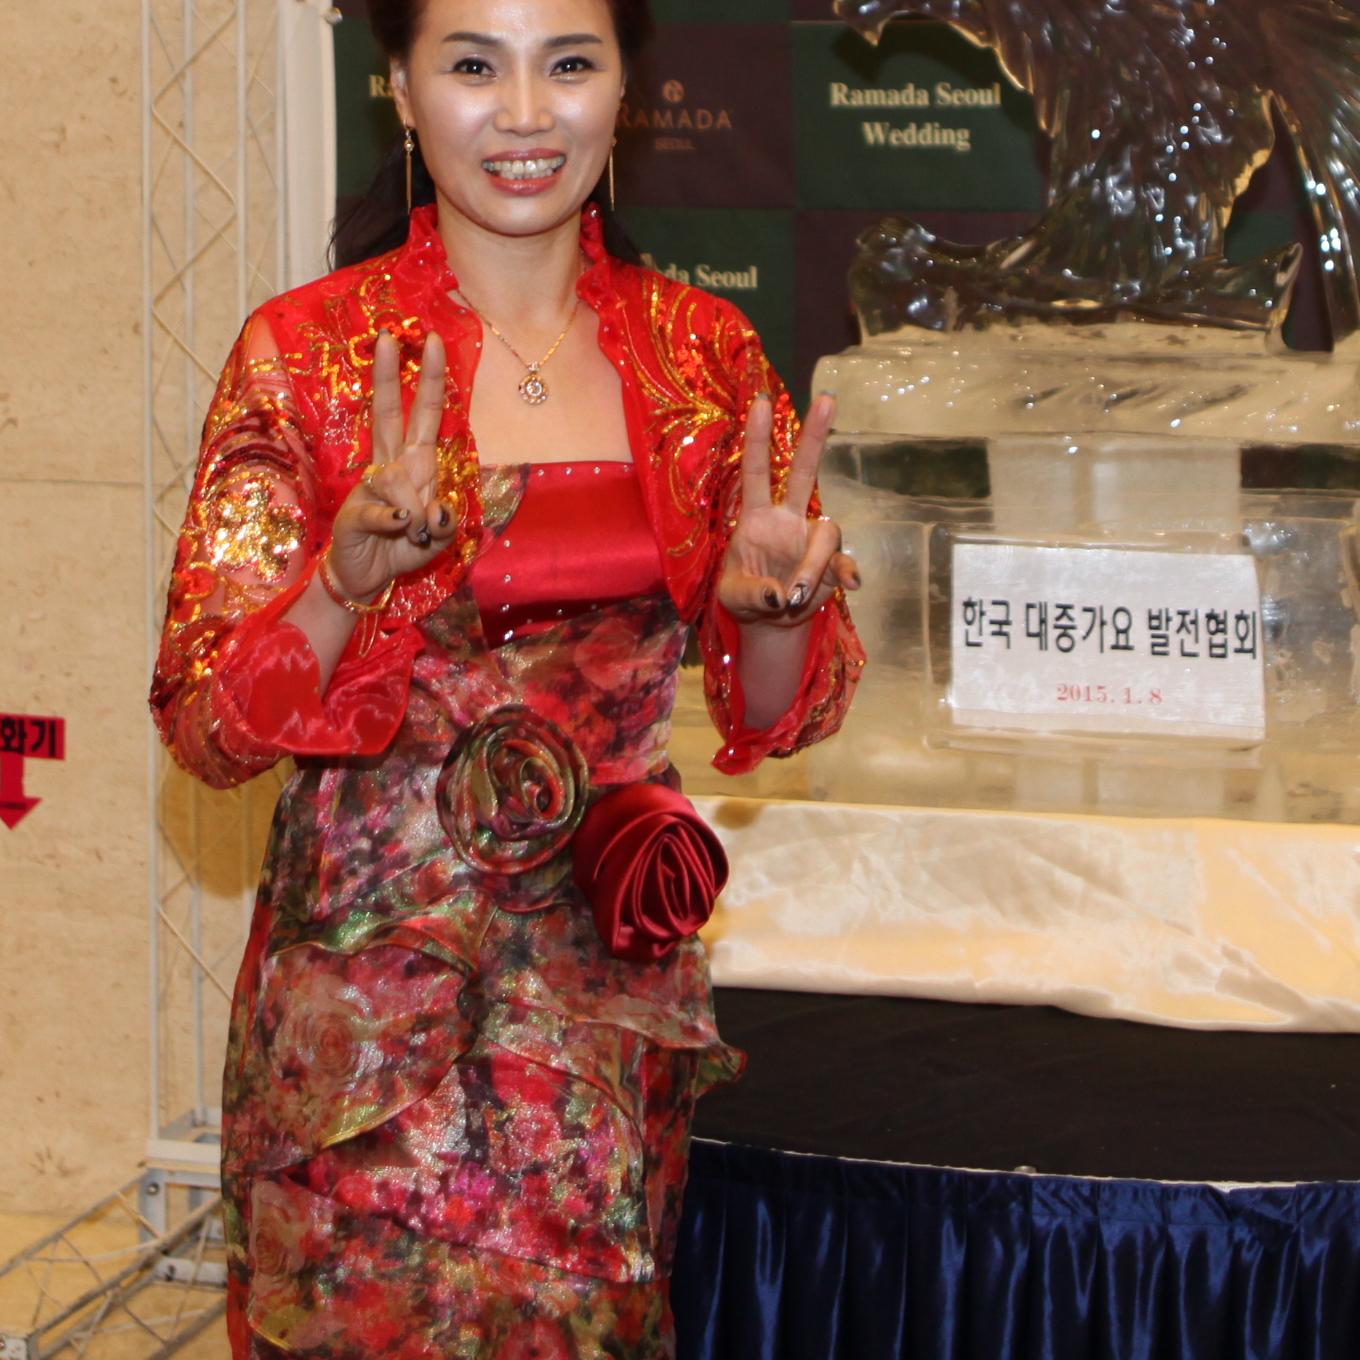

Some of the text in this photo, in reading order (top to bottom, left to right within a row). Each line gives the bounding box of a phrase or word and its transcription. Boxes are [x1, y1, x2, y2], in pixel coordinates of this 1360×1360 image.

[831, 83, 1000, 107] Ramada Seoul
[863, 122, 970, 151] Wedding
[695, 264, 757, 288] Seoul
[961, 596, 1259, 660] 한국 대중가요 발전협회
